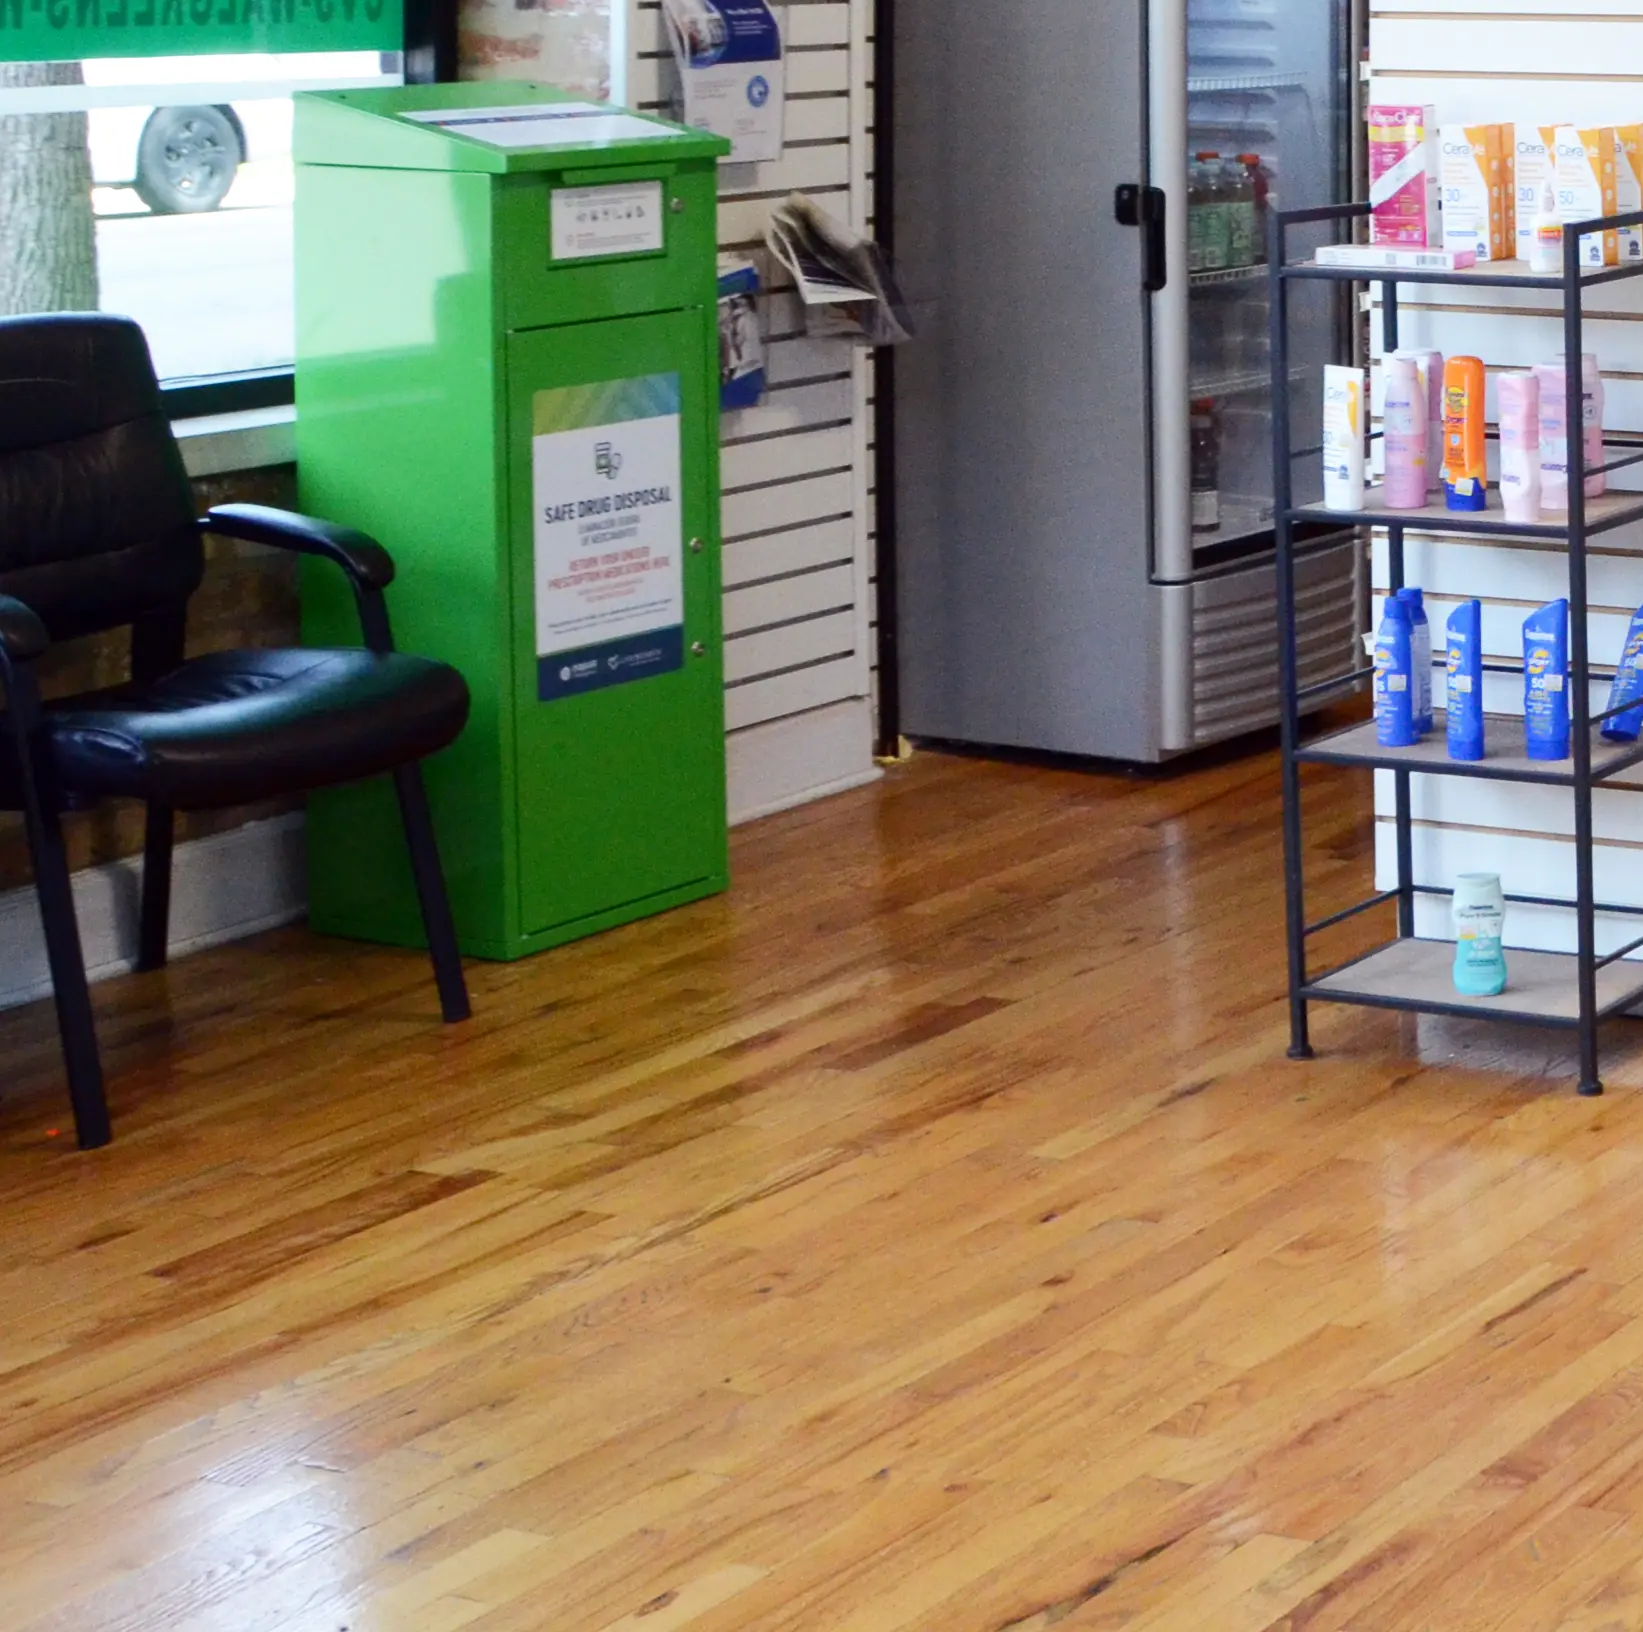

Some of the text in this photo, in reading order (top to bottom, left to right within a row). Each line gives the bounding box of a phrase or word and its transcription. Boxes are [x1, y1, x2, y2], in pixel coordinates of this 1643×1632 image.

[545, 485, 673, 525] SAFE DRUG DISPOSAL
